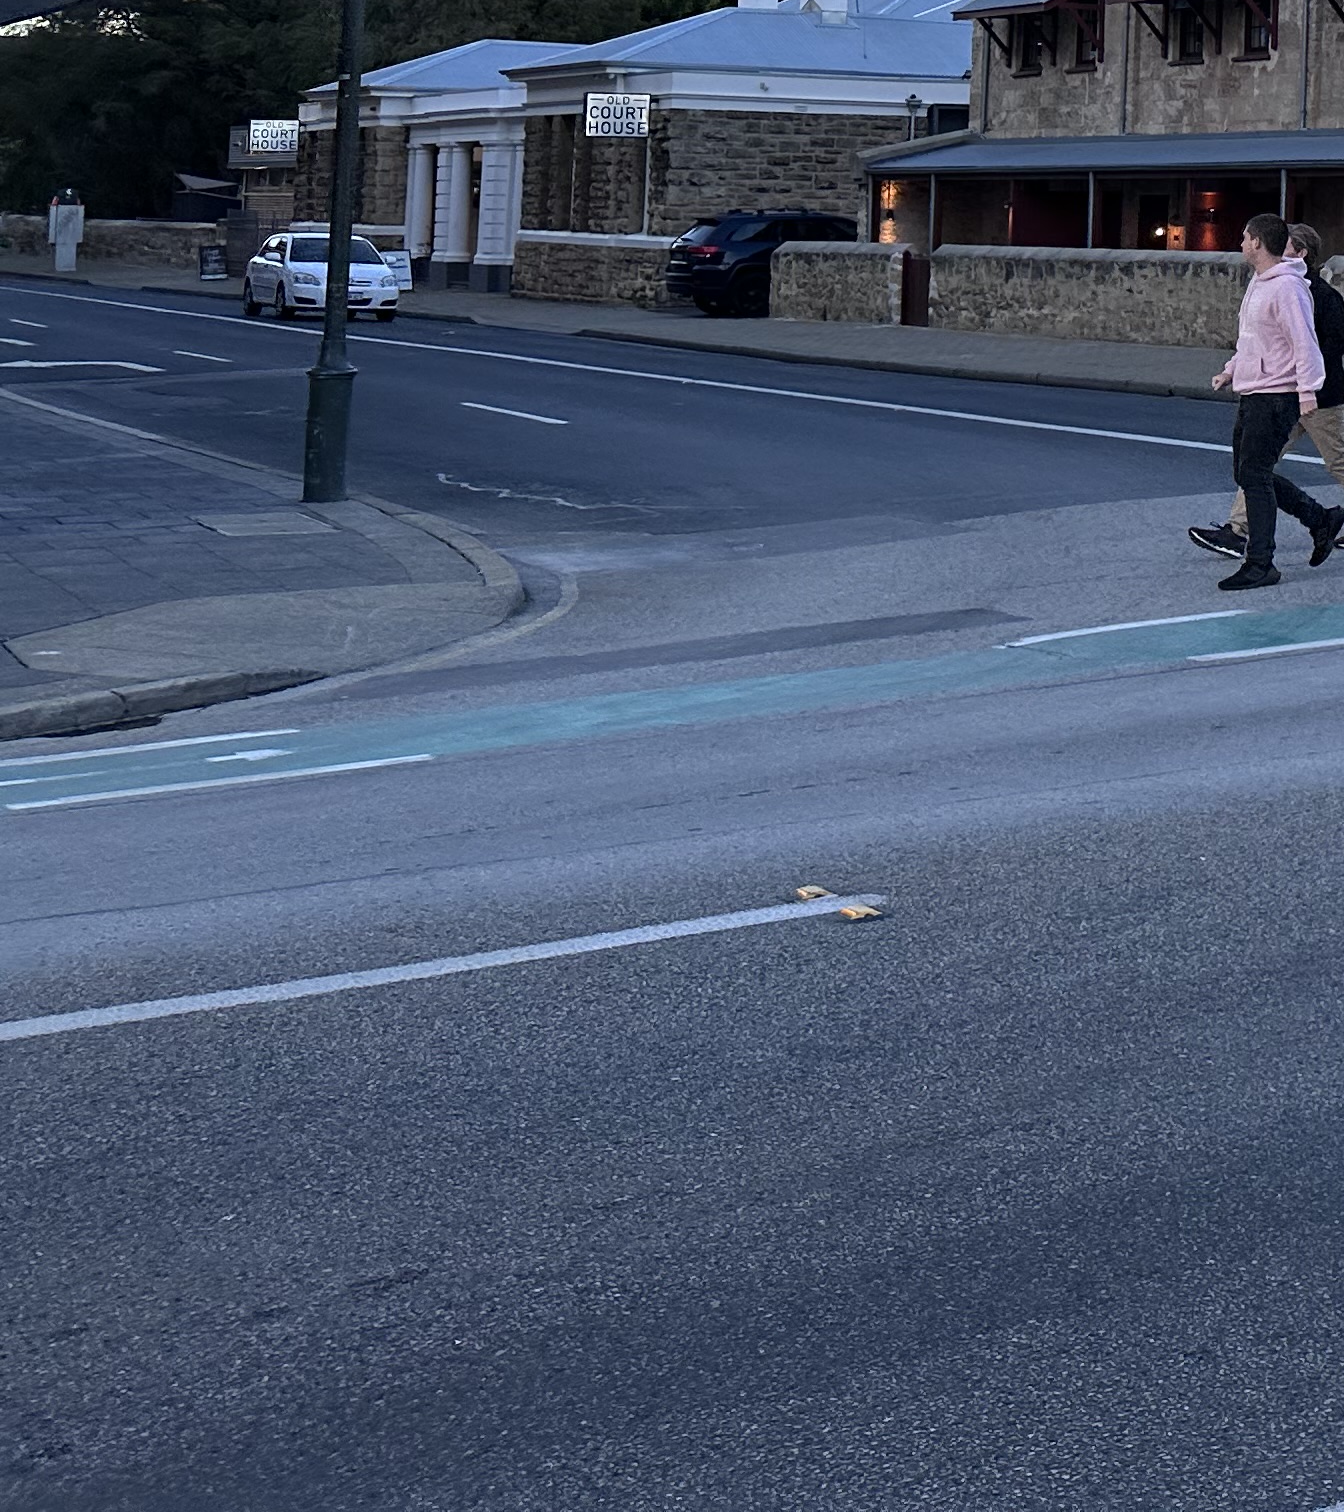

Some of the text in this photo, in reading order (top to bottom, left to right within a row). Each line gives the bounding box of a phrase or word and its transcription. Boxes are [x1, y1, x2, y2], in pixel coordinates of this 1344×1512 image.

[606, 95, 631, 105] OLD
[589, 105, 647, 119] COURT
[265, 121, 284, 129] OLD
[588, 120, 647, 135] HOUSE
[252, 128, 297, 139] COURT
[251, 139, 297, 150] HOUSE
